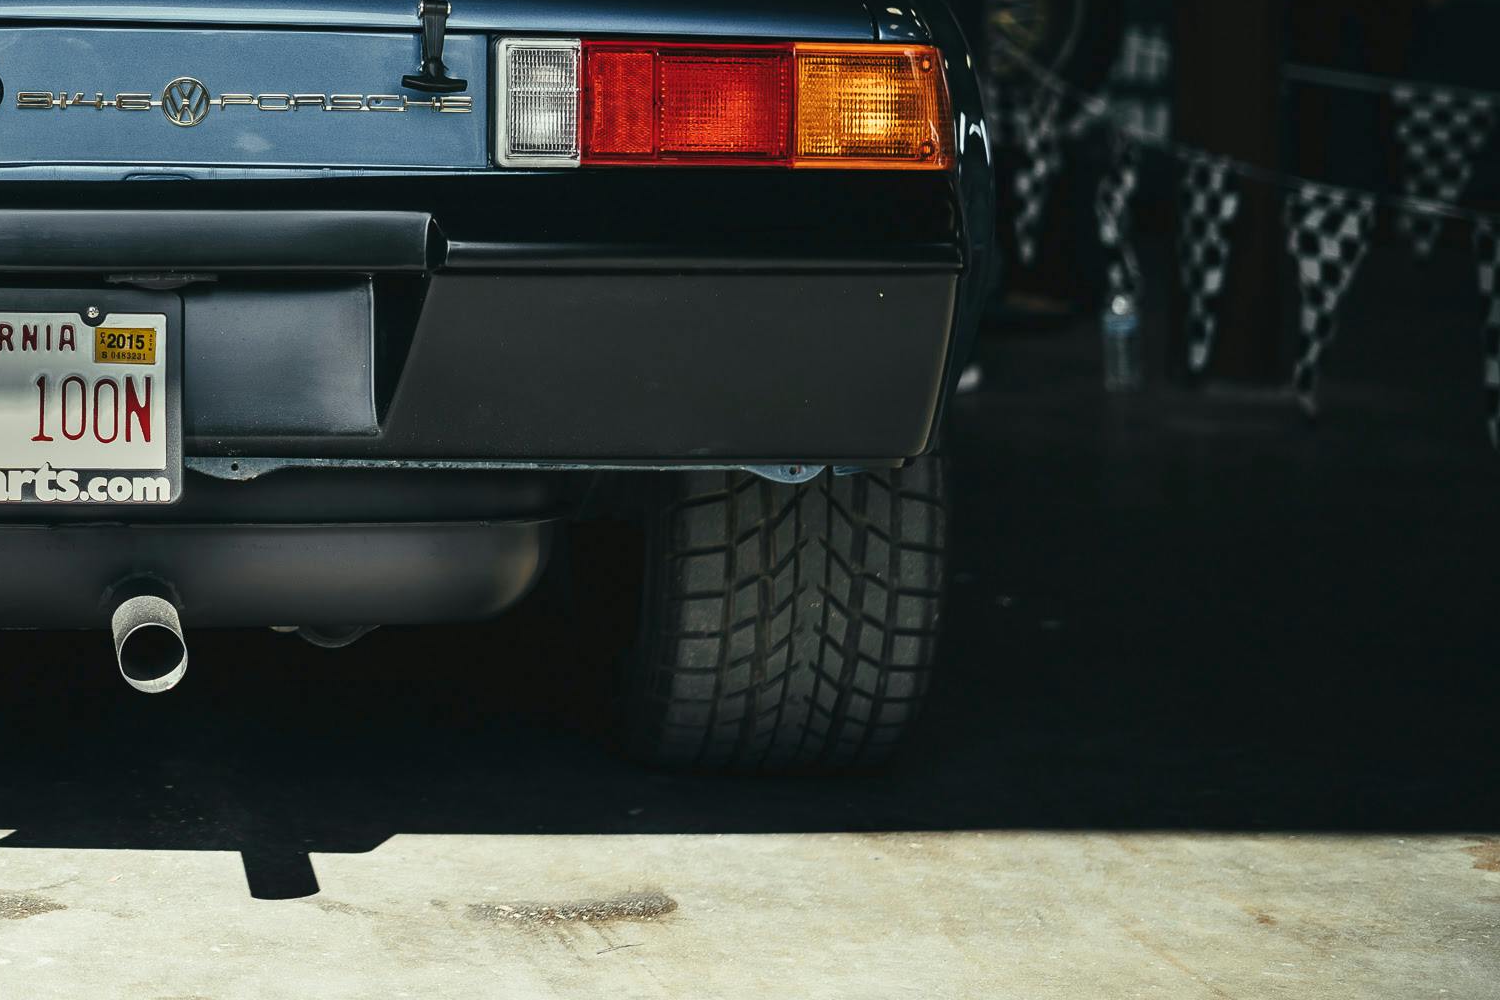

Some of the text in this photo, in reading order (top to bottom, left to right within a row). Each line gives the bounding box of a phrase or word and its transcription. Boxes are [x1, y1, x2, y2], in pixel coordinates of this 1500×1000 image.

[220, 93, 472, 113] PORSCHE
[106, 333, 145, 350] 2015
[31, 374, 152, 444] 100N
